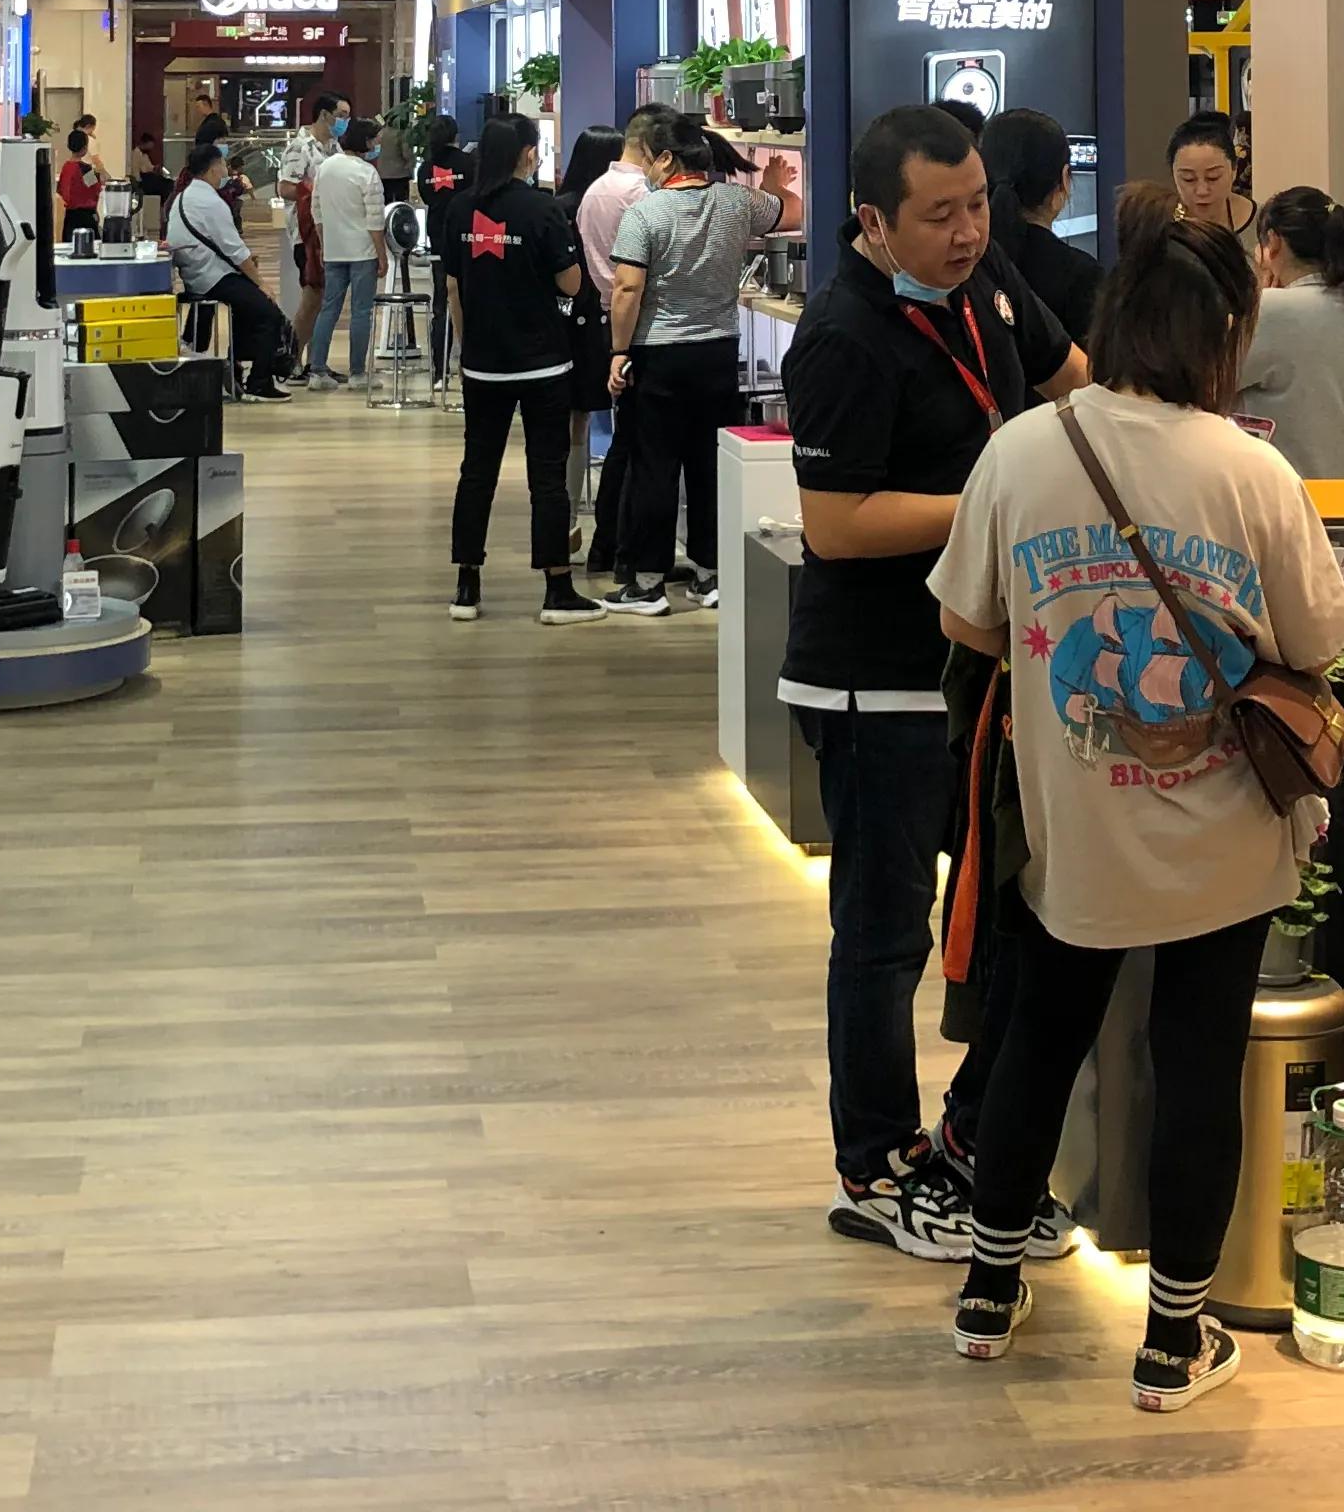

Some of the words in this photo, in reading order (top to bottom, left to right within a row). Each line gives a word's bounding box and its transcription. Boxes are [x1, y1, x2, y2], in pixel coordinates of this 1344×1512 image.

[302, 26, 325, 40] 3F
[1012, 526, 1081, 594] THE
[1085, 522, 1263, 617] MAFLOWER
